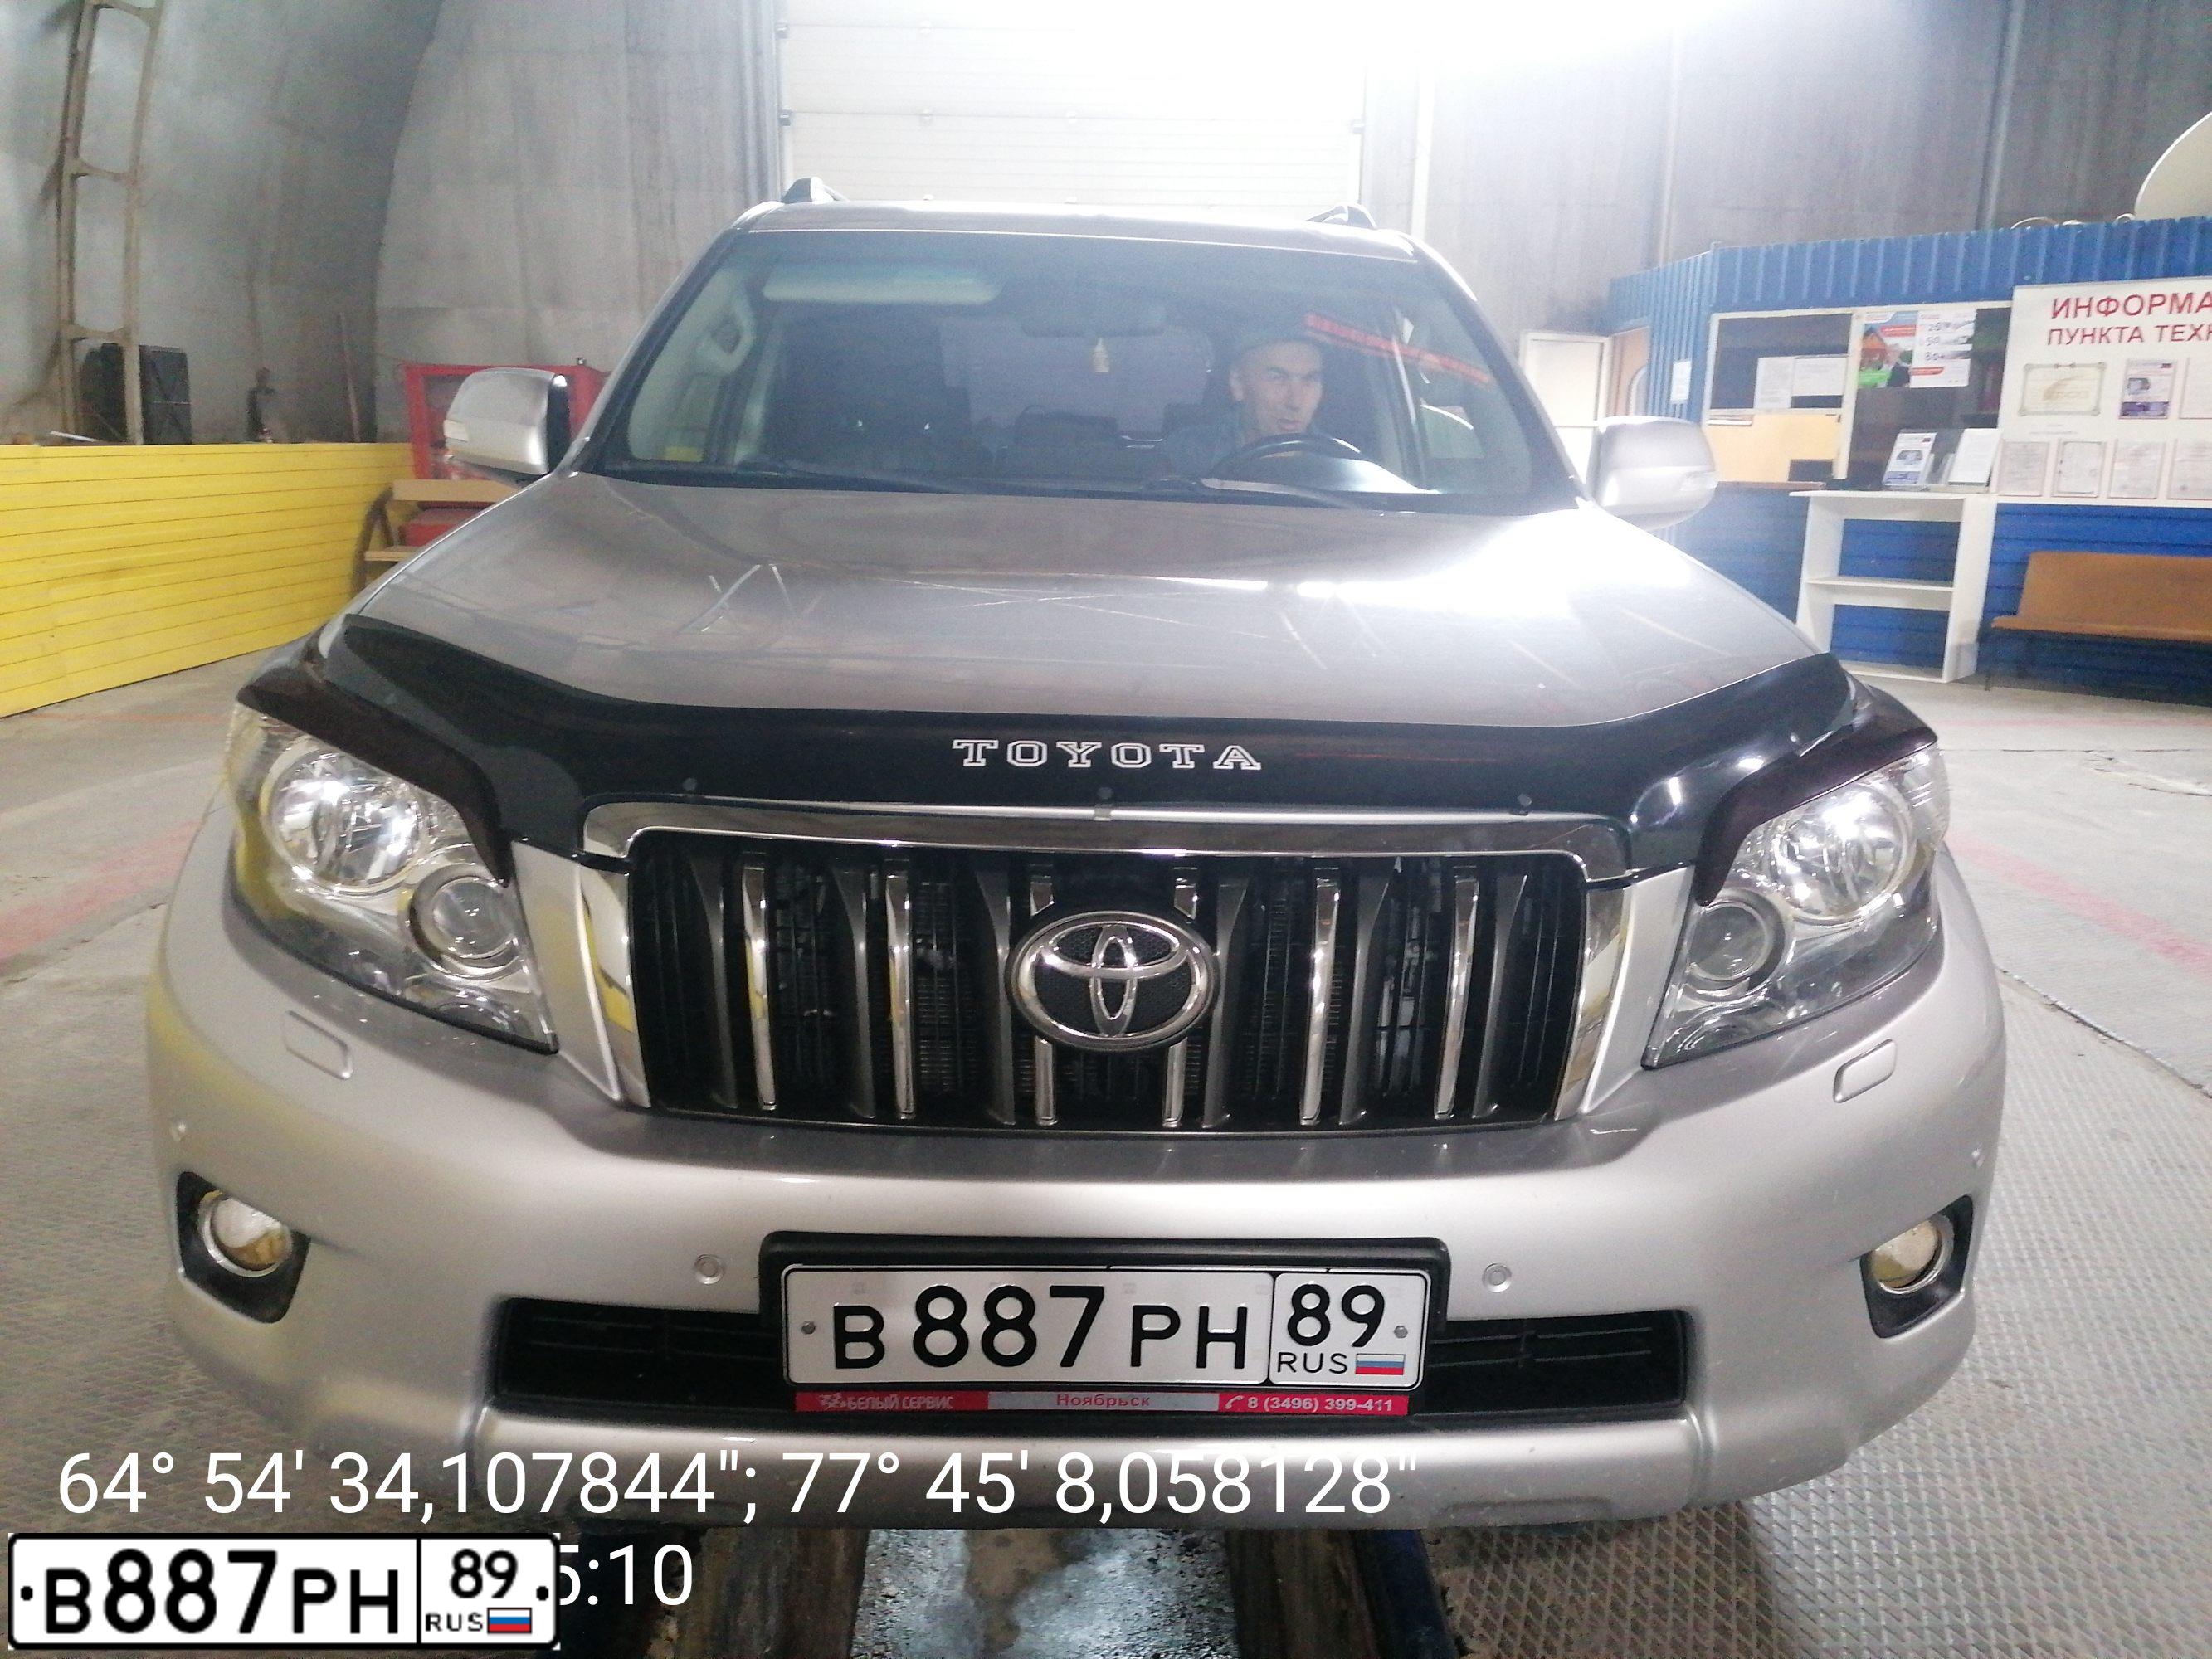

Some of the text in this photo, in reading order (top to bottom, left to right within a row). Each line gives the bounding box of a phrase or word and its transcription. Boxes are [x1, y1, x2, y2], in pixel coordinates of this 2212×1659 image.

[2051, 291, 2212, 319] ИНФОРМА
[2047, 326, 2144, 345] ПУНКТА
[953, 739, 1261, 771] TOYOTA
[1288, 1283, 1385, 1348] 89
[1277, 1351, 1348, 1374] RUS
[847, 1394, 953, 1410] БЕЛЫЙ СЕРВИС
[1056, 1394, 1150, 1408] Ноябрьск
[1247, 1396, 1393, 1412] 8 (3496) 399-411
